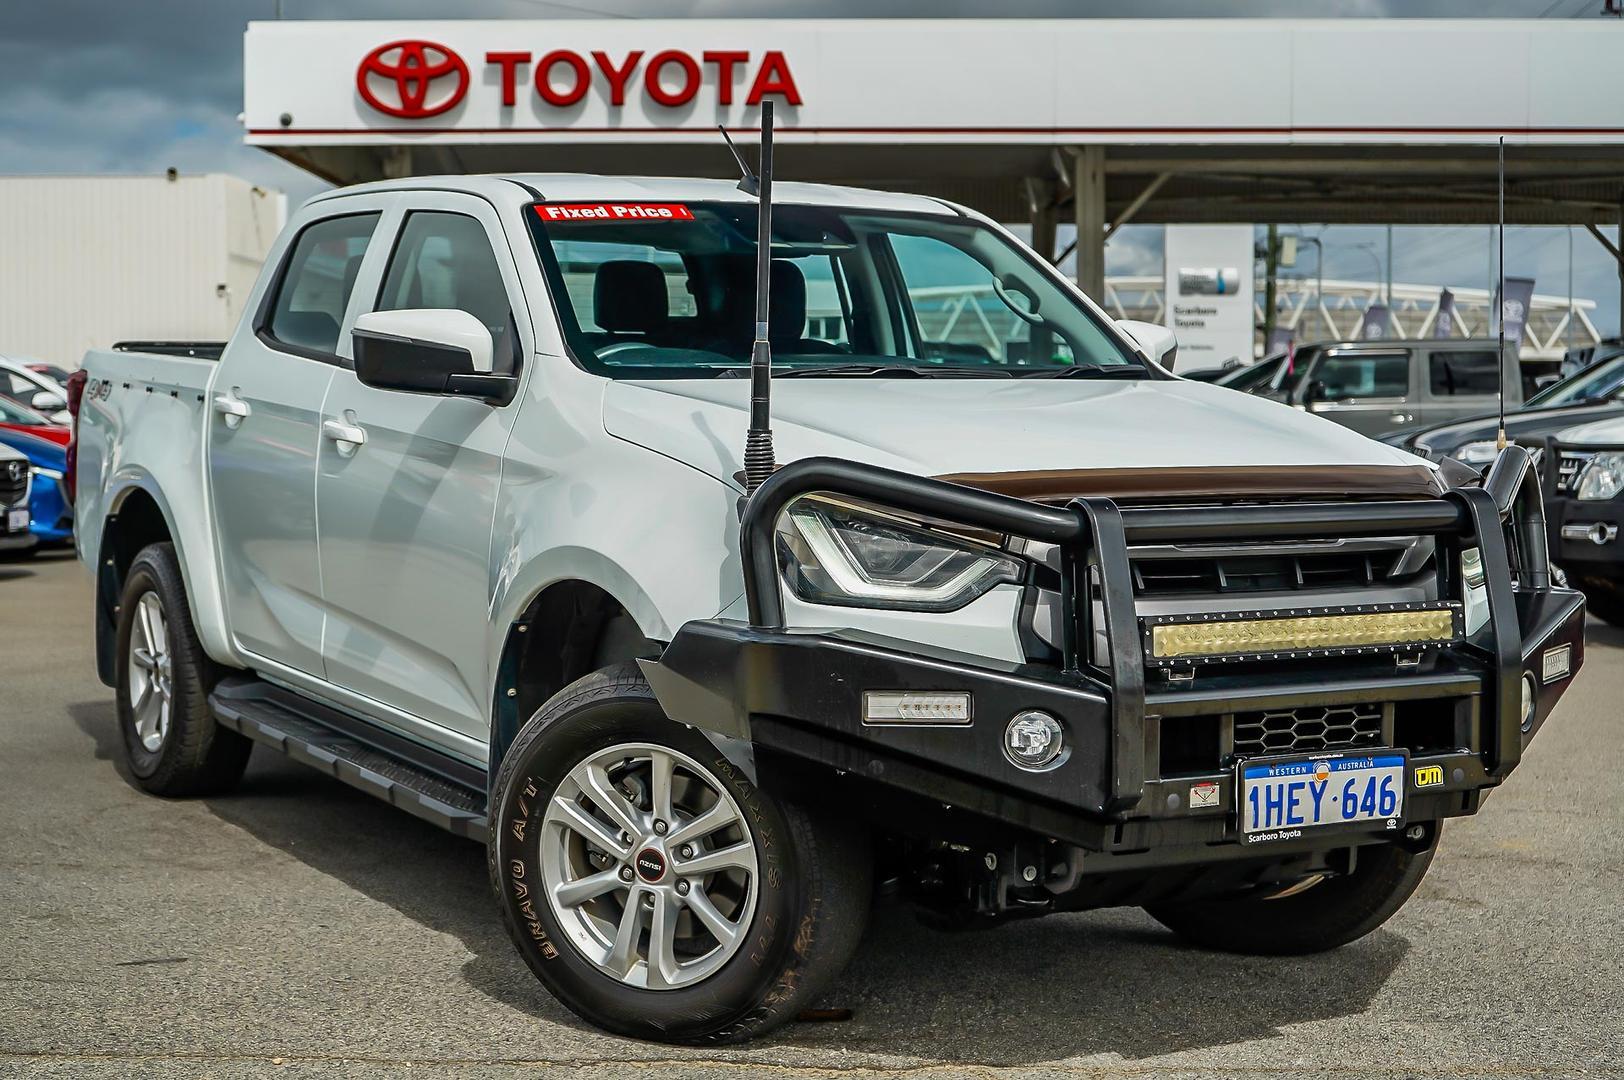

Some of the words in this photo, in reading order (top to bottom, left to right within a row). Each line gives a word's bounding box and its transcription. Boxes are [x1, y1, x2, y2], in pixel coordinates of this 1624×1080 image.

[485, 49, 803, 107] TOYOTA
[545, 206, 610, 219] Fixed
[612, 205, 673, 218] Price
[1269, 766, 1307, 776] WESTERN
[1338, 760, 1374, 770] AUSTRALIA
[1248, 831, 1278, 843] Scarboro
[1279, 829, 1302, 841] Toyota
[639, 859, 662, 871] ISUZU
[511, 858, 560, 961] BRAVO
